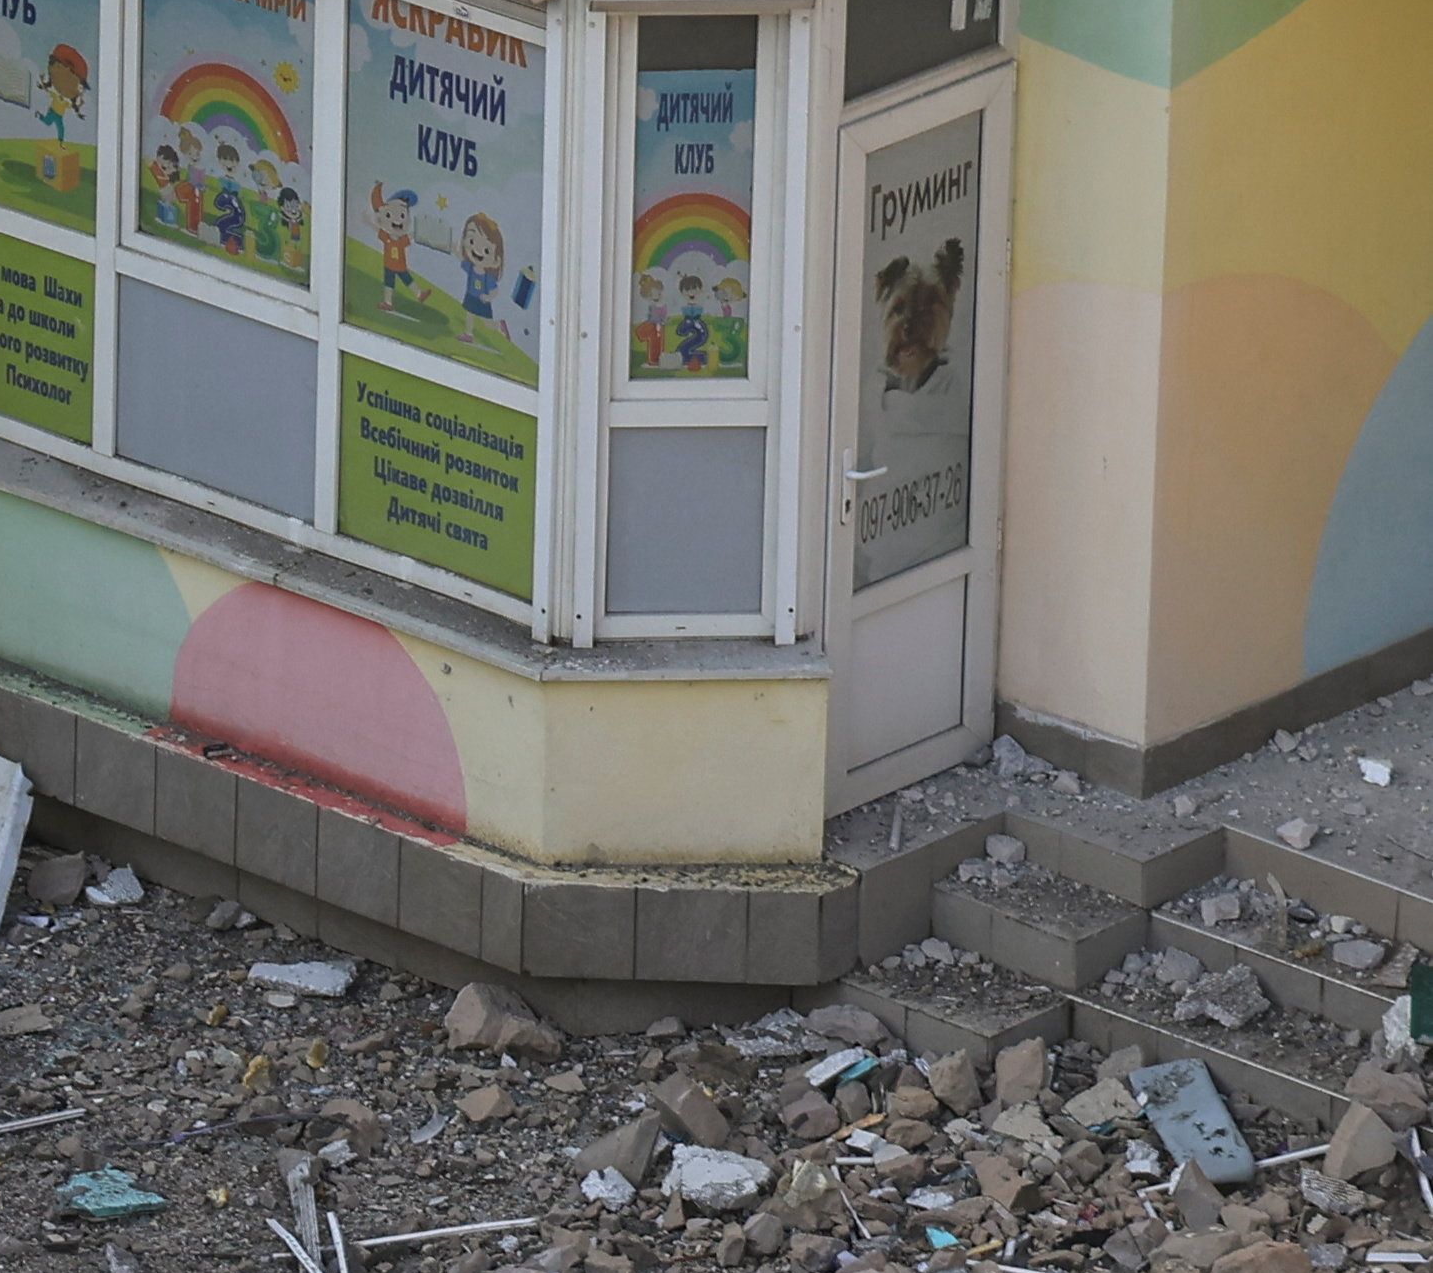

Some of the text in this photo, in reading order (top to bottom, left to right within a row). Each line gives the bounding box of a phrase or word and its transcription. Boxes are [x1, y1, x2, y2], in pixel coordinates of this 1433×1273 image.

[389, 54, 506, 126] ДИТЯЧИЙ
[657, 82, 733, 132] ДИТЯЧИЙ
[418, 124, 478, 177] КЛУБ
[675, 143, 714, 174] КЛУБ
[870, 160, 972, 241] Груминг
[1, 265, 36, 292] мова
[44, 275, 82, 308] Шахи
[7, 302, 25, 323] до
[29, 309, 76, 339] школи
[6, 363, 72, 405] Психолог
[25, 341, 89, 383] розвитку
[357, 380, 524, 461] Успішна соціалізація
[360, 416, 519, 493] Всебічний розвиток
[373, 455, 504, 522] Цікаве дозвілля
[861, 462, 962, 544] 097-906-37-26
[387, 496, 488, 551] Дитячі свята
